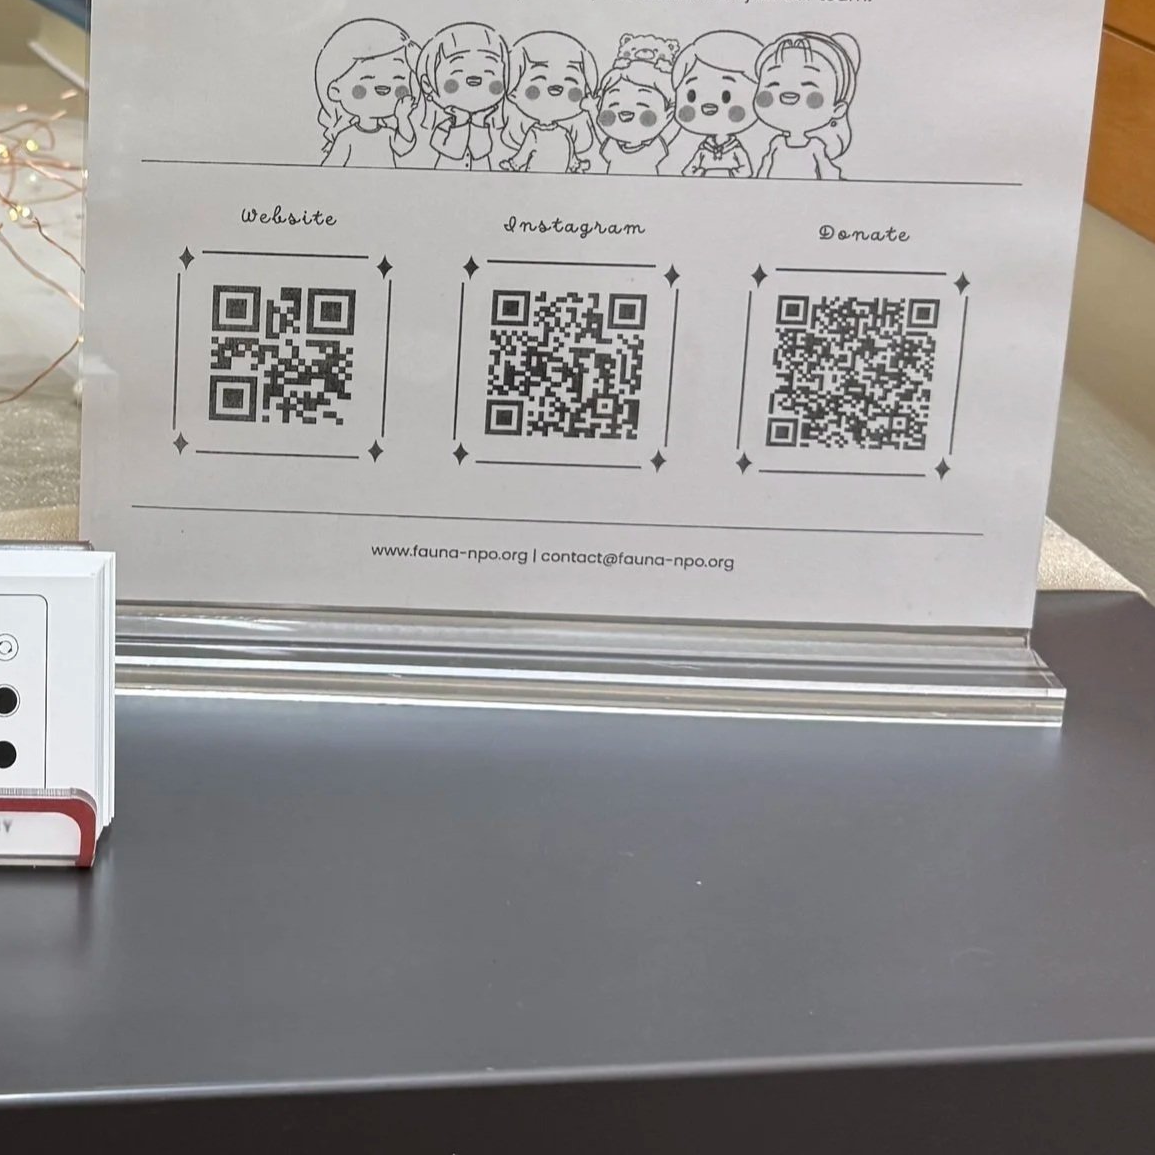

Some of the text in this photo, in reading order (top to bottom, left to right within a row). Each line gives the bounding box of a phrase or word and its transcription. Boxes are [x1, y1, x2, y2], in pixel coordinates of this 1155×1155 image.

[241, 204, 338, 227] Website
[503, 215, 646, 240] Instagram
[818, 224, 911, 243] Donate
[371, 544, 735, 573] www.fauna-npo.org contact@fauna-npo.org
